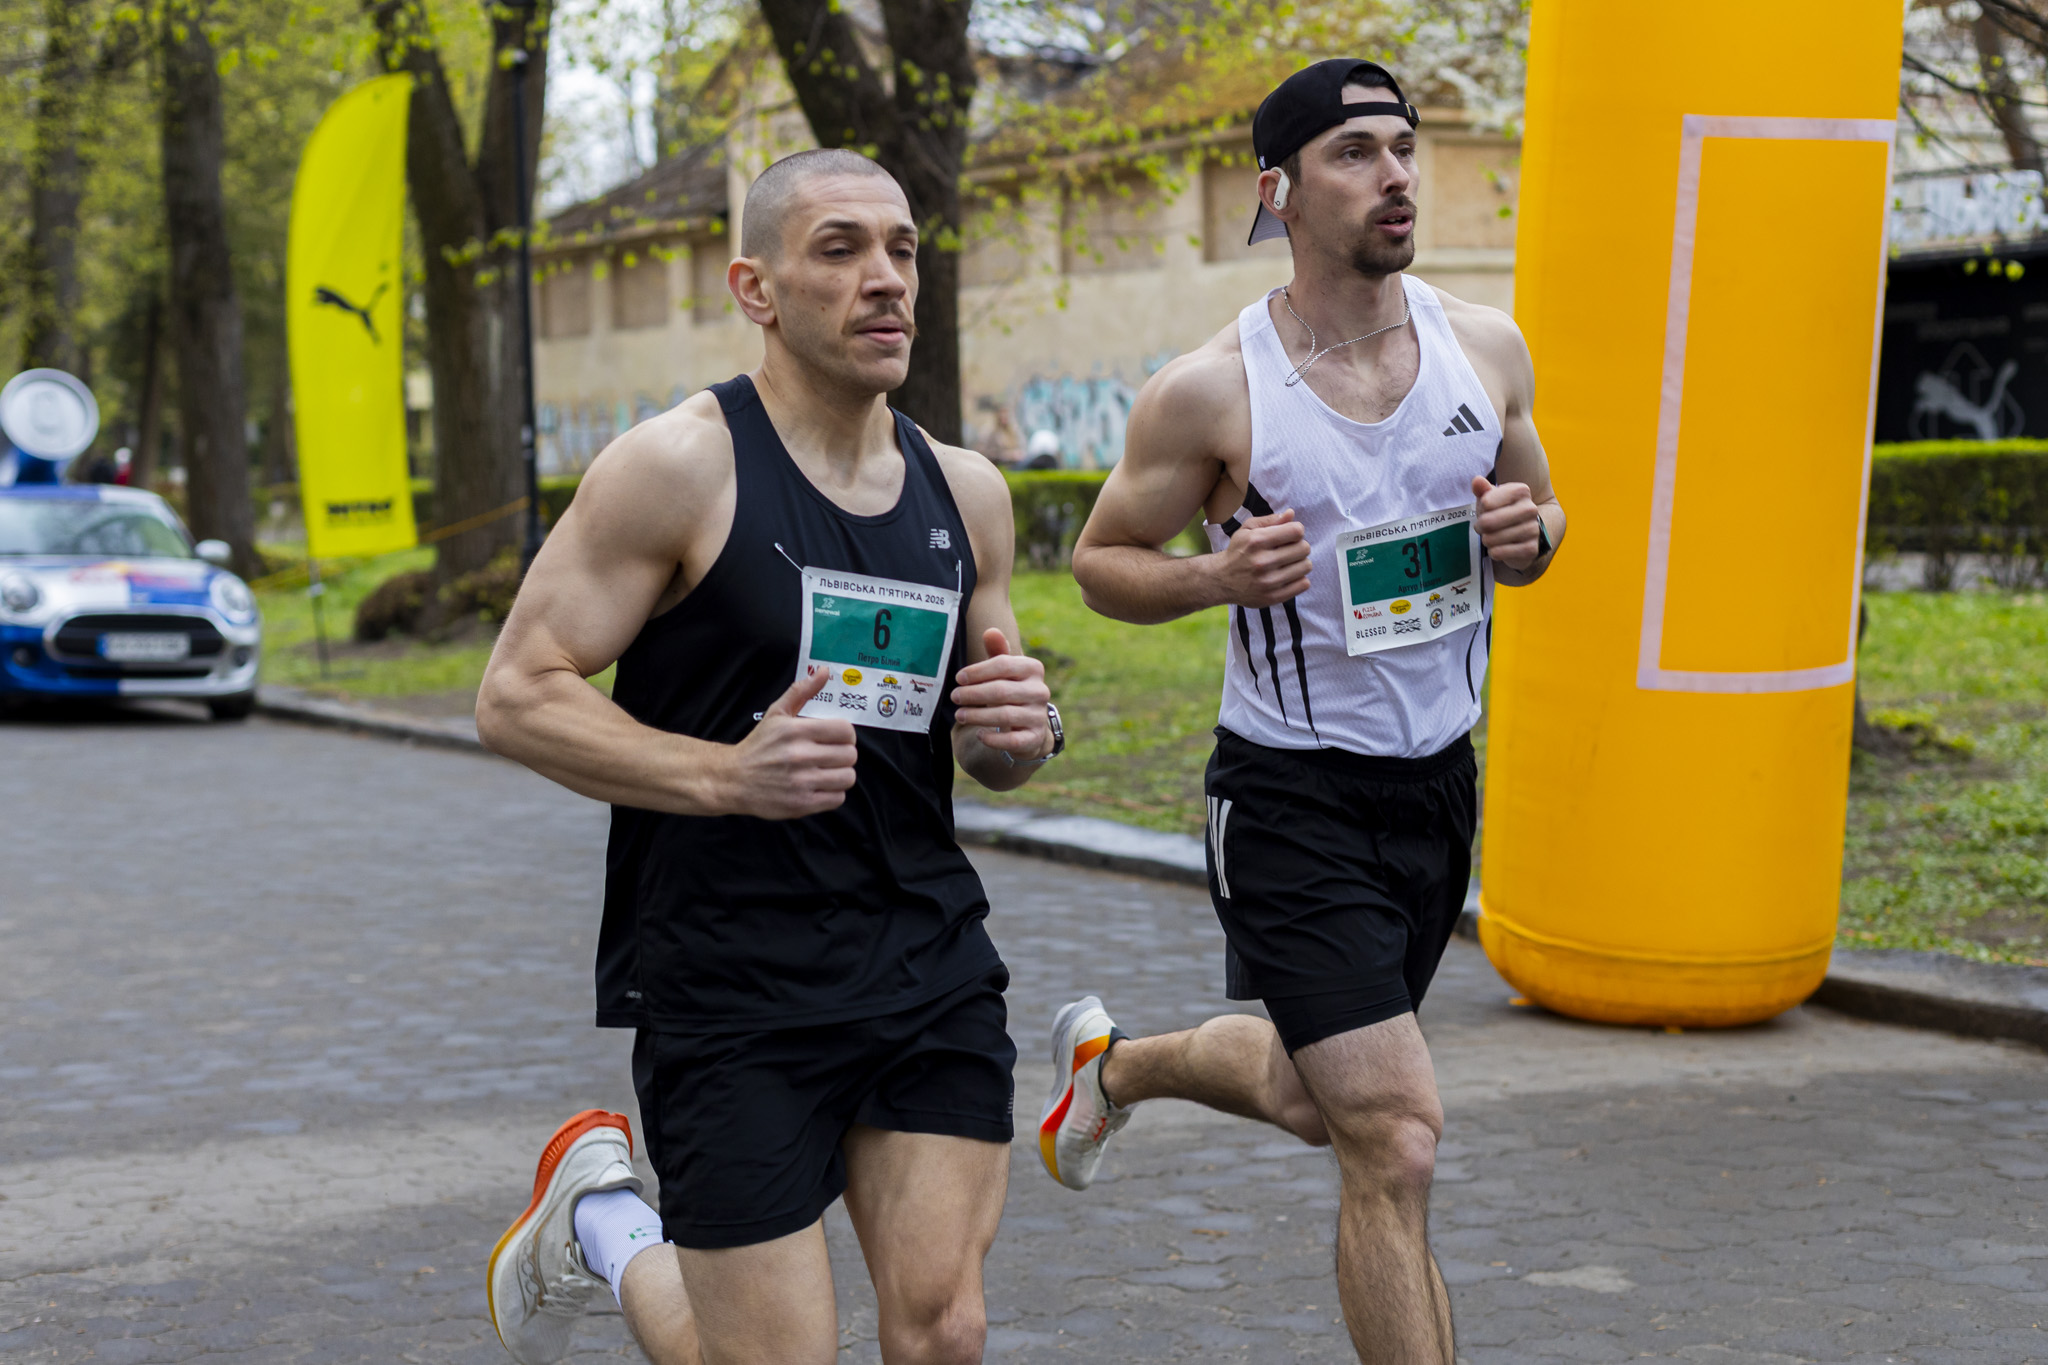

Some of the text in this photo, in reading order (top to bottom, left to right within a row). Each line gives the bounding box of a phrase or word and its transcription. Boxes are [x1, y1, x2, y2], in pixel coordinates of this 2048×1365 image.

[1353, 510, 1467, 543] ЛЬВІВСЬКА П'ЯТІРКА 2026
[1401, 538, 1433, 579] 31
[819, 578, 945, 605] ЛЬВІВСЬКА П'ЯТІРКА 2026
[1398, 583, 1418, 593] Артур
[873, 608, 892, 650] 6
[1356, 625, 1387, 639] BLESSED
[857, 652, 879, 665] Петро
